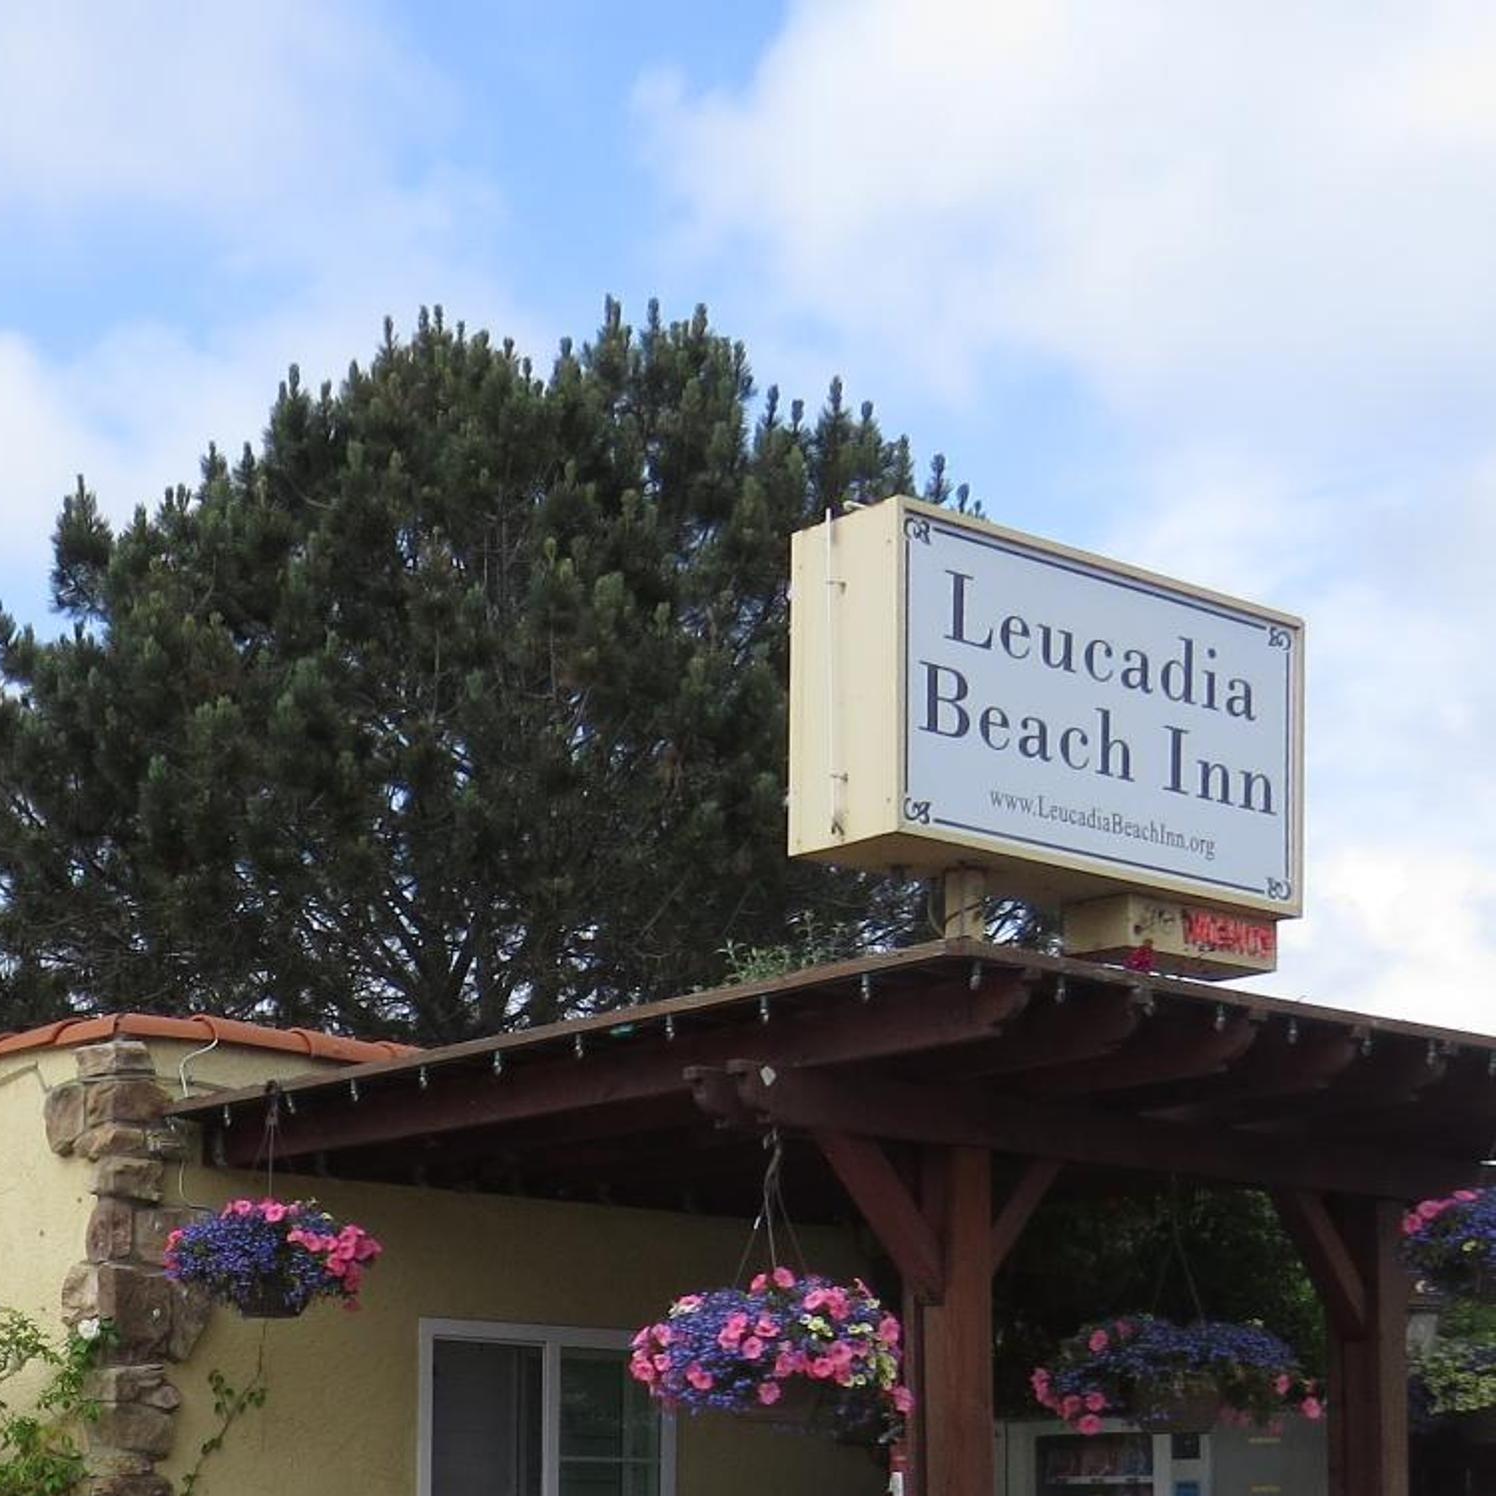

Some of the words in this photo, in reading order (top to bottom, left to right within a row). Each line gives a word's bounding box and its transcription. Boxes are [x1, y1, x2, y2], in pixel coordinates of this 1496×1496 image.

[944, 570, 1256, 721] Leucadia
[919, 660, 1135, 781] Beach
[1163, 725, 1277, 815] Inn
[990, 789, 1215, 860] www.LeucadiaBeachInn.org
